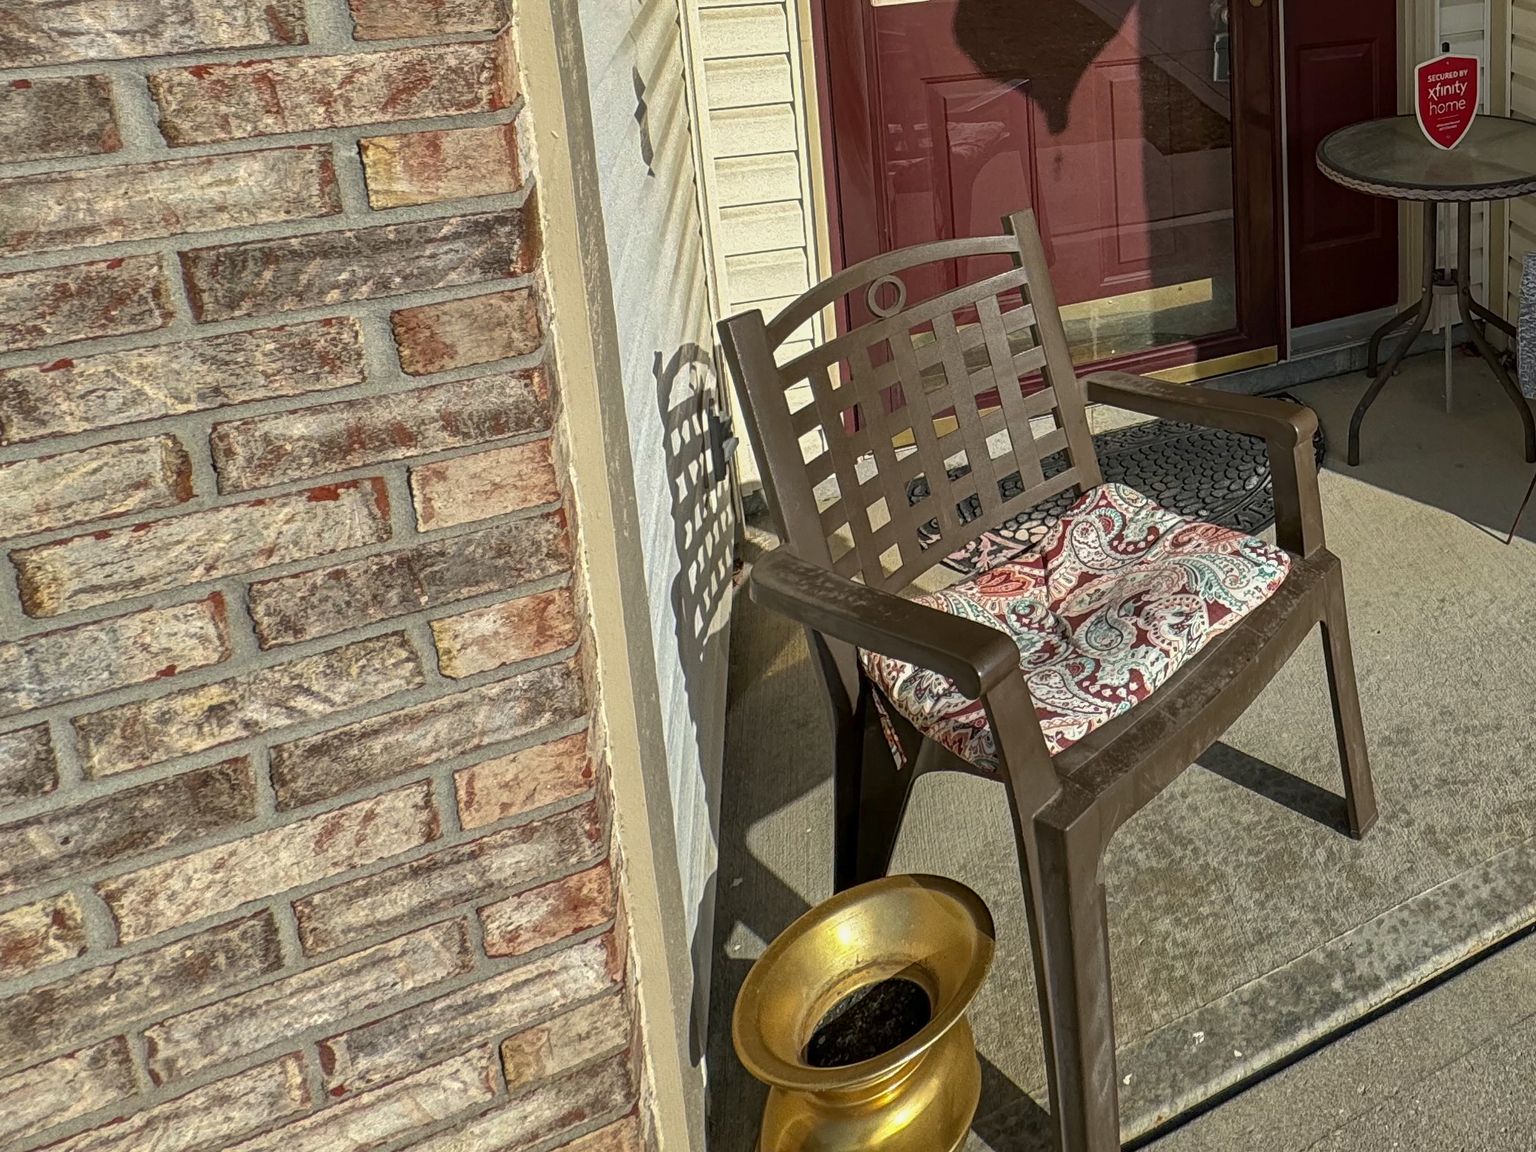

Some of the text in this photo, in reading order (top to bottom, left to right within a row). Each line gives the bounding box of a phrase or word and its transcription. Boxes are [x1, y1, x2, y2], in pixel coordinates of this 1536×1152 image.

[1427, 69, 1469, 83] SECURED BY
[1427, 80, 1468, 101] xfinity
[1429, 99, 1466, 116] home
